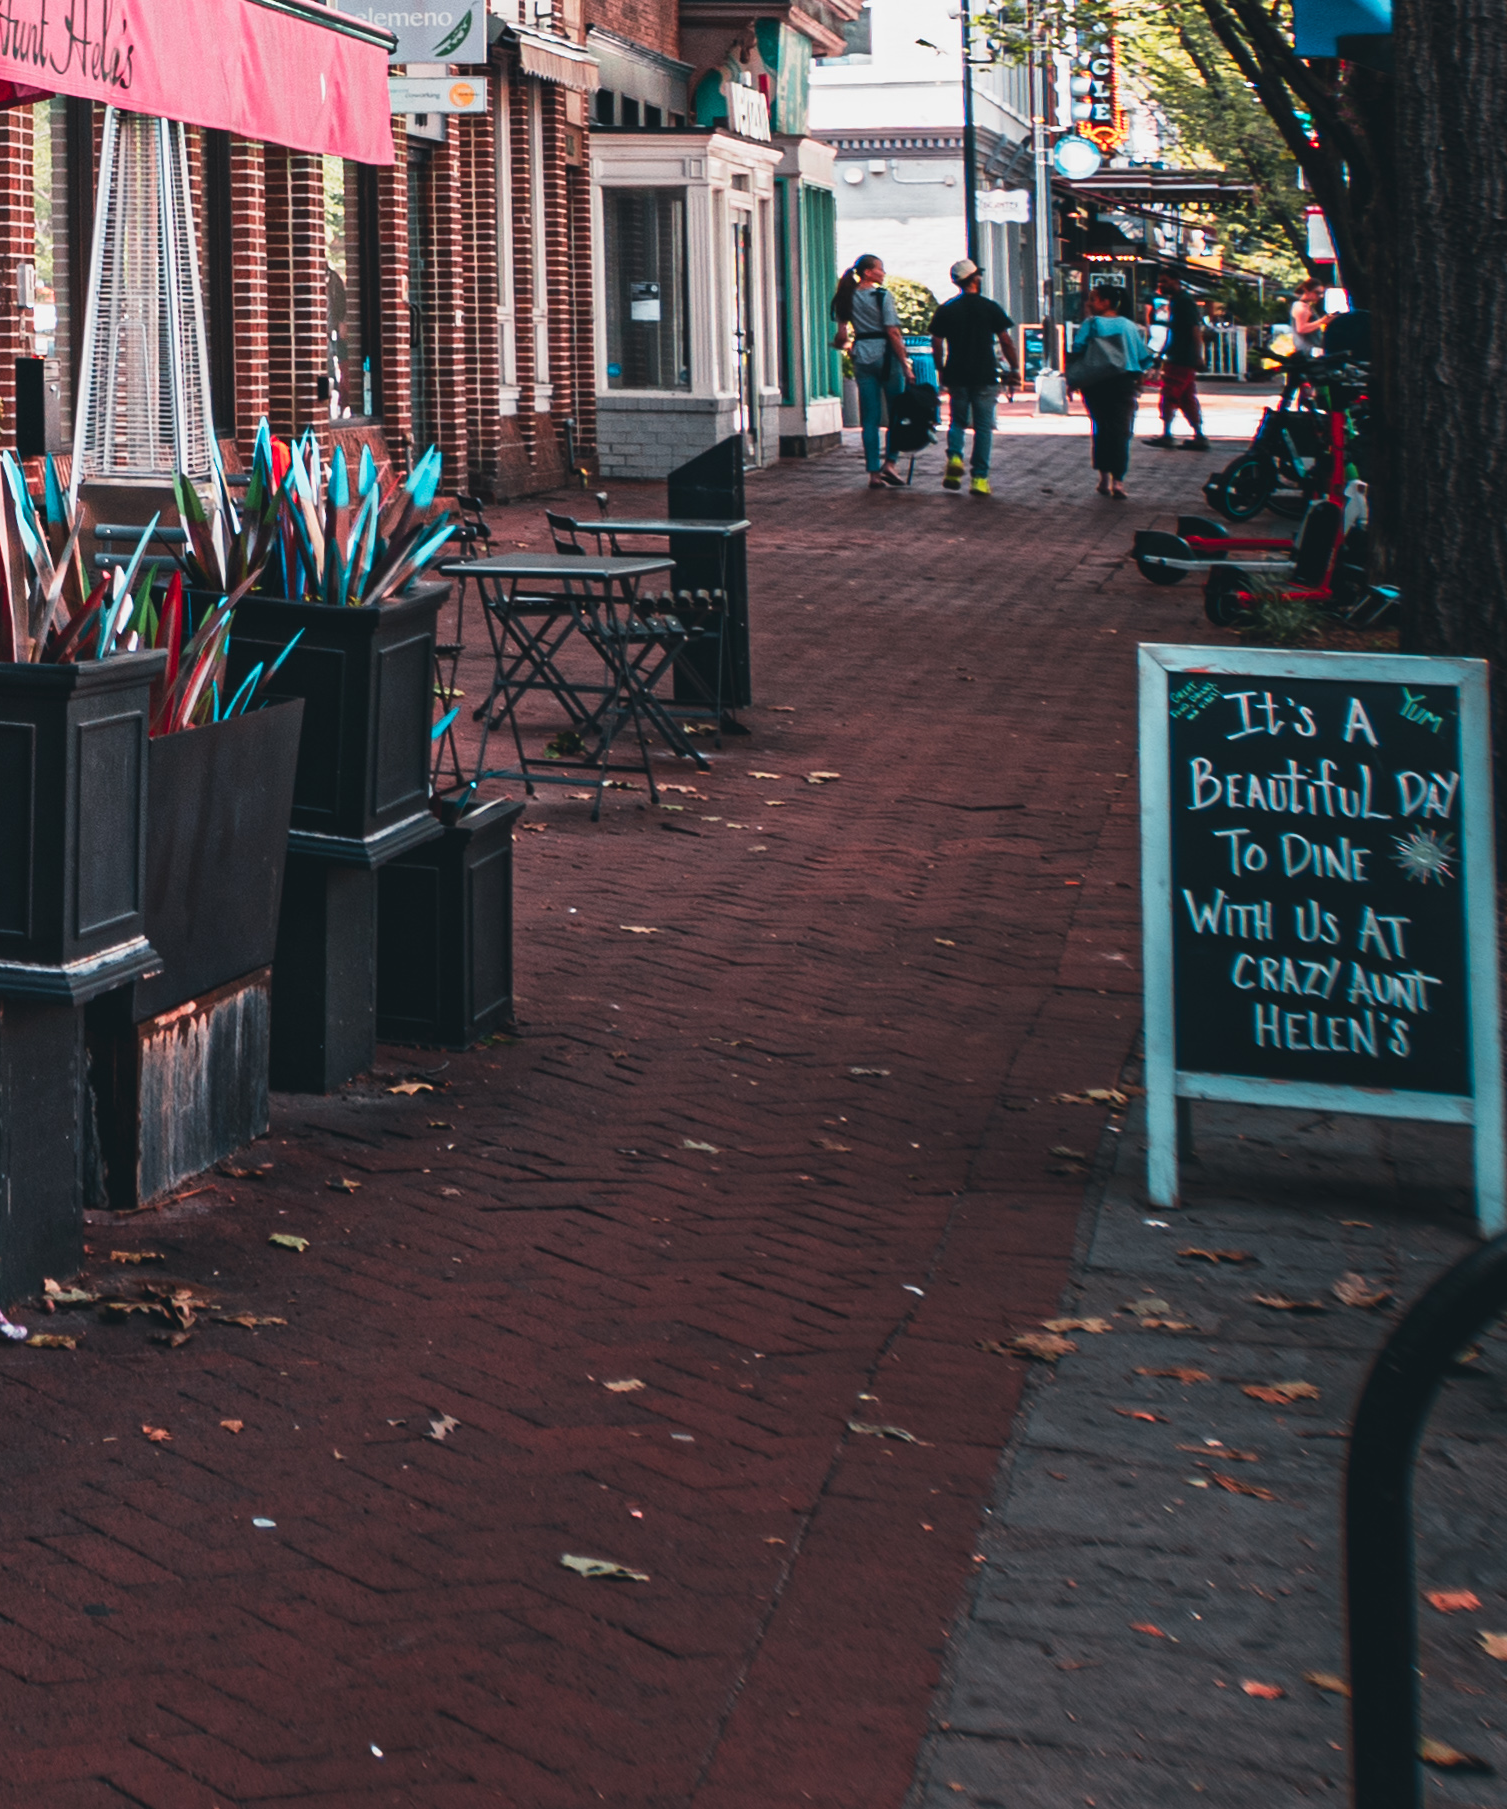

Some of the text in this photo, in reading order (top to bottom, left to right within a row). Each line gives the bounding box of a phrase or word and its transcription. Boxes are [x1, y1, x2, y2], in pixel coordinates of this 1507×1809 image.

[1223, 691, 1380, 748] It's A
[1399, 686, 1443, 733] YUM
[1397, 771, 1459, 819] DAY
[1282, 833, 1372, 882] DINE
[1357, 905, 1411, 961] AT
[1232, 952, 1443, 1014] CRAZY AUNT
[1253, 1001, 1411, 1058] HELEN'S
